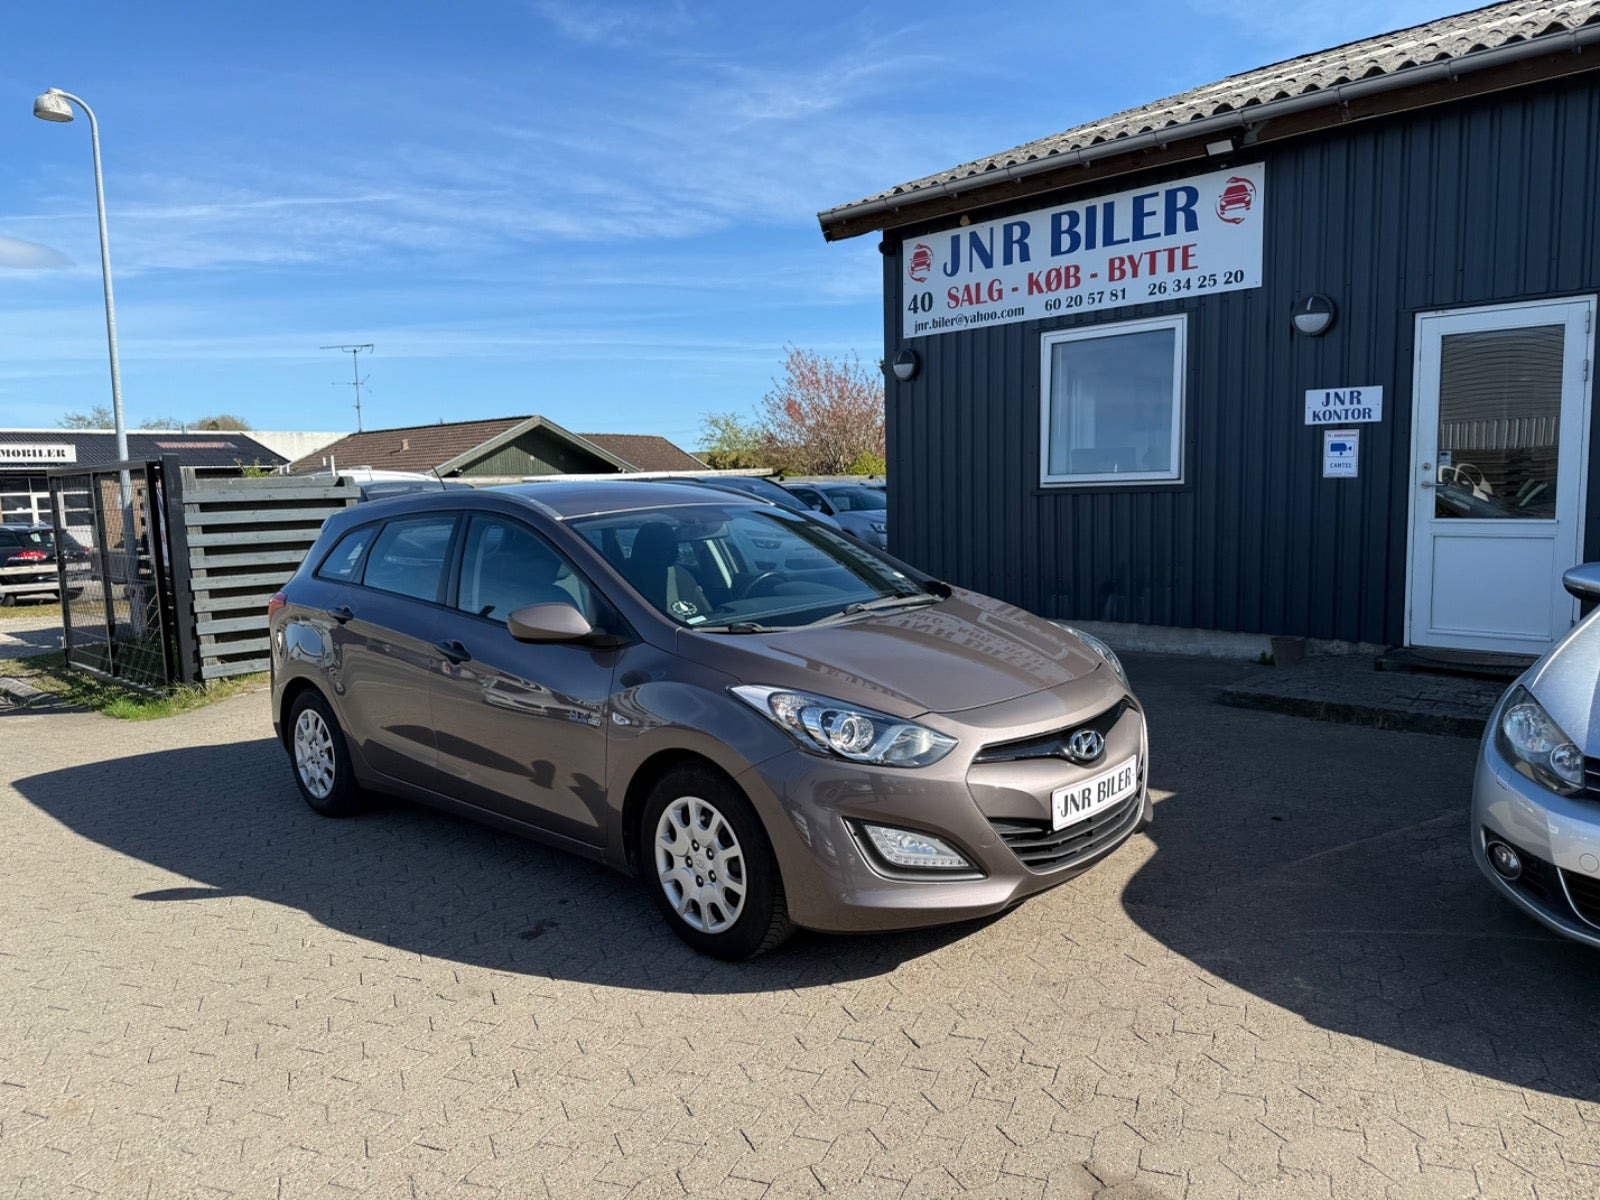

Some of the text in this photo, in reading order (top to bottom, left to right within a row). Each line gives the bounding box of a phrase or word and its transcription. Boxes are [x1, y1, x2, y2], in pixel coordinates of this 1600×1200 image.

[943, 185, 1199, 277] JNR BILER
[947, 278, 1003, 309] SALG
[1028, 264, 1081, 296] KØB
[1108, 243, 1198, 282] BYTTE
[908, 291, 933, 314] 40
[1044, 269, 1245, 312] 60 20 57 81 26 34 25 20
[914, 306, 1025, 334] jnr.biler@yahoo.com
[1322, 390, 1362, 407] JNR
[1312, 407, 1372, 422] KONTOR
[0, 449, 66, 458] MOBILER
[1060, 767, 1131, 818] JNR BILER
